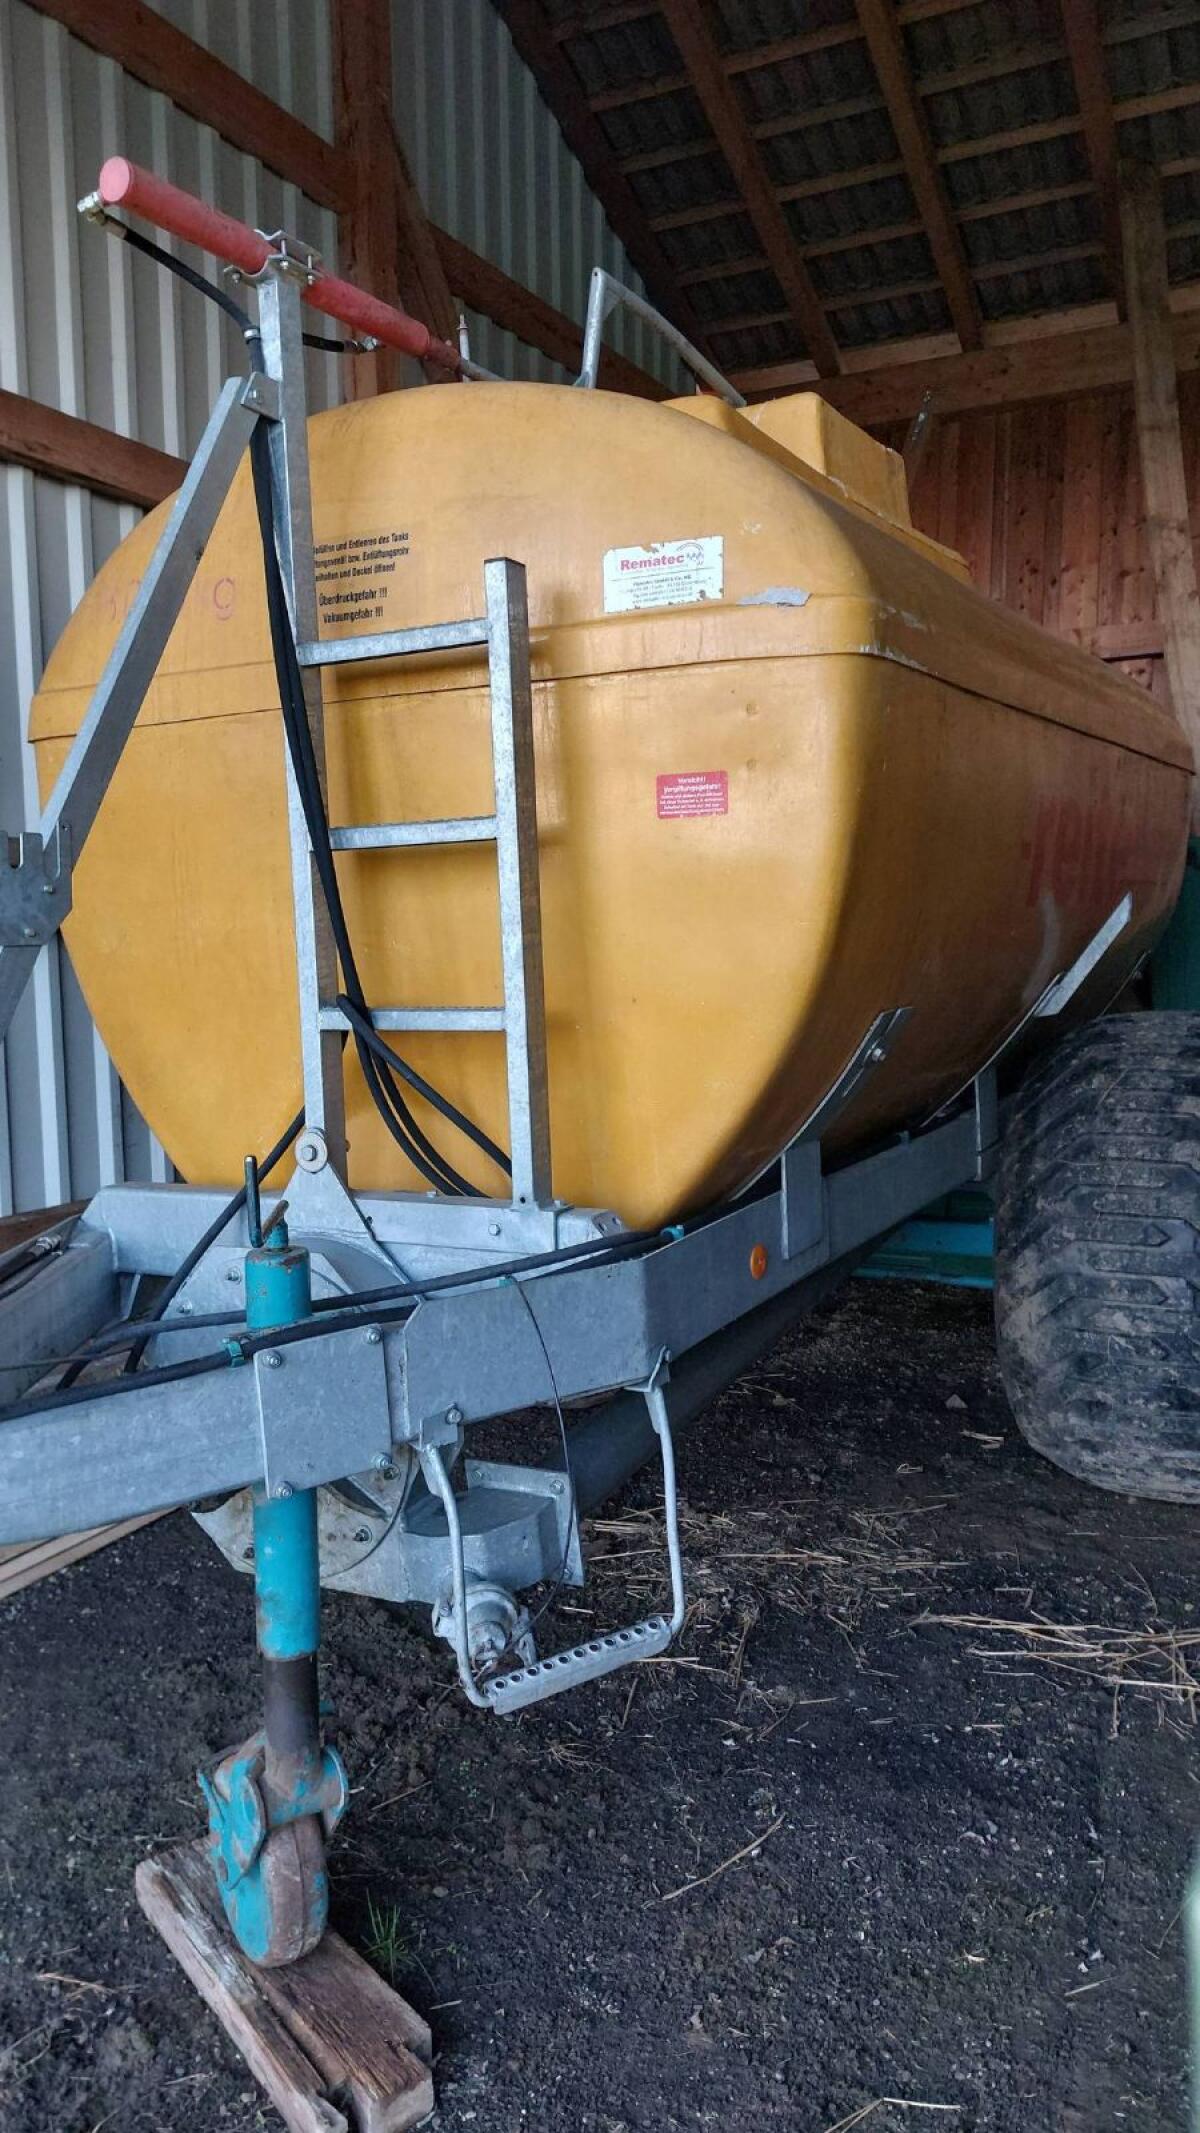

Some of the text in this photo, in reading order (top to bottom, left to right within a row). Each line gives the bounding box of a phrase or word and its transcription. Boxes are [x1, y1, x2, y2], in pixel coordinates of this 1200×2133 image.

[336, 541, 347, 551] und
[379, 535, 390, 545] des
[392, 532, 409, 542] Tanks
[620, 554, 685, 570] Rematec
[340, 569, 351, 578] und
[319, 589, 376, 606] Überdruckgefahr
[323, 607, 373, 624] Vakuumgefahr
